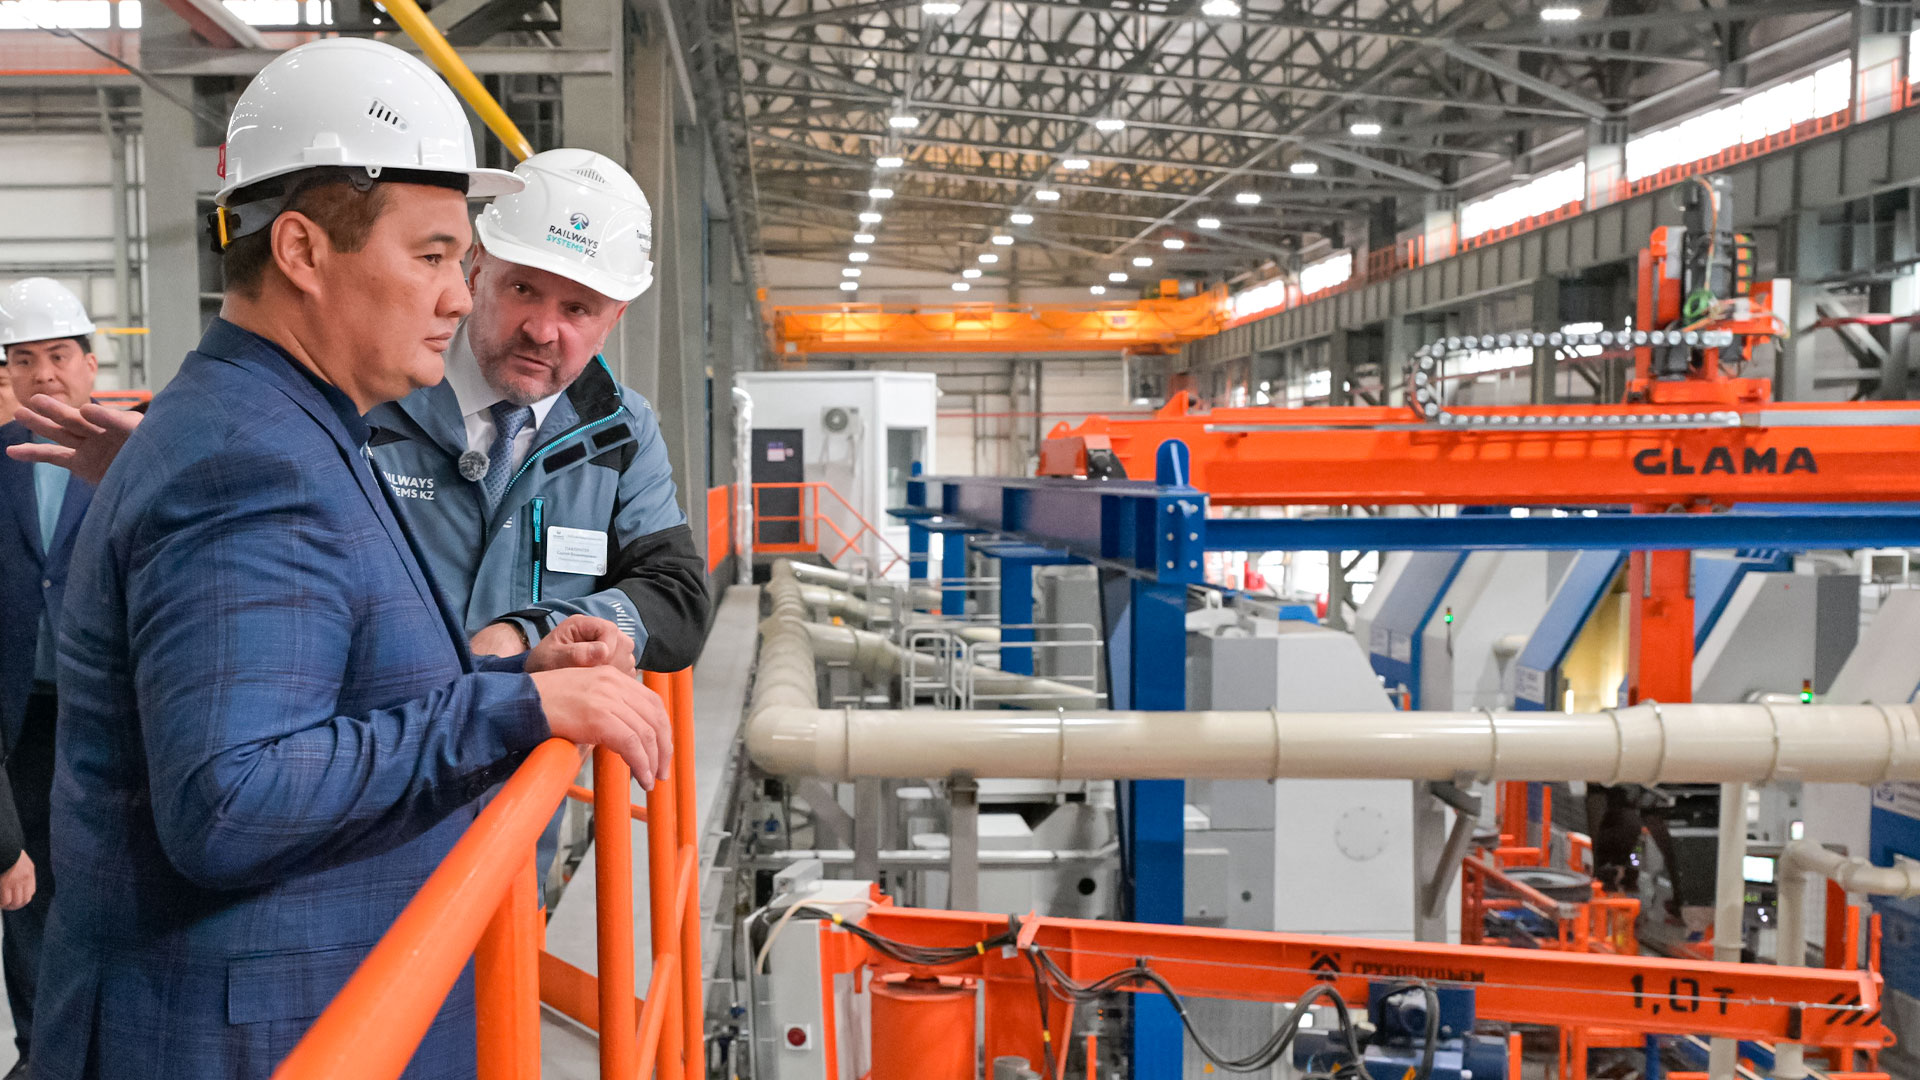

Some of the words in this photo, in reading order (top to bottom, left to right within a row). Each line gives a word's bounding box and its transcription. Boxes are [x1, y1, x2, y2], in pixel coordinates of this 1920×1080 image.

[546, 234, 584, 254] SYSTEMS
[584, 248, 598, 258] KZ
[548, 225, 599, 250] RAILWAYS
[1633, 446, 1818, 475] GLAMA
[383, 471, 434, 489] ILWAYS
[420, 490, 435, 500] KZ
